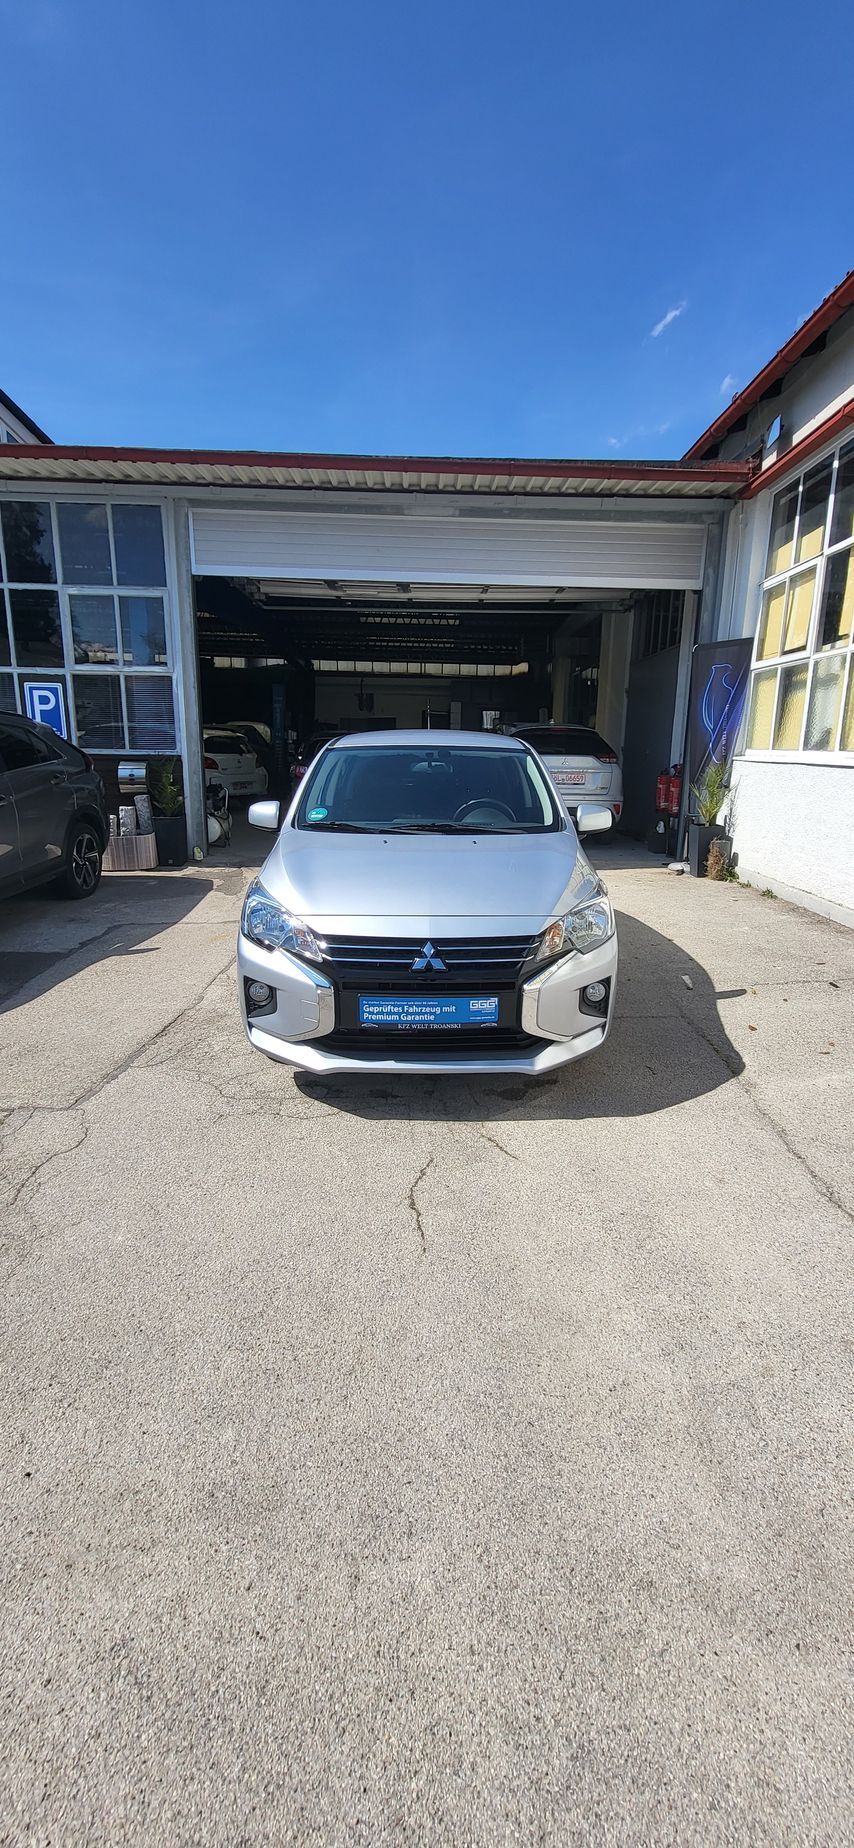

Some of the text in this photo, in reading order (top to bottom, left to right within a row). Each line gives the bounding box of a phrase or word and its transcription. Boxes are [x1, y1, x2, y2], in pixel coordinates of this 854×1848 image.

[33, 690, 56, 722] P
[363, 1004, 402, 1014] Geprüftes
[404, 1005, 440, 1014] Fahrzeug
[470, 1000, 495, 1008] GGG
